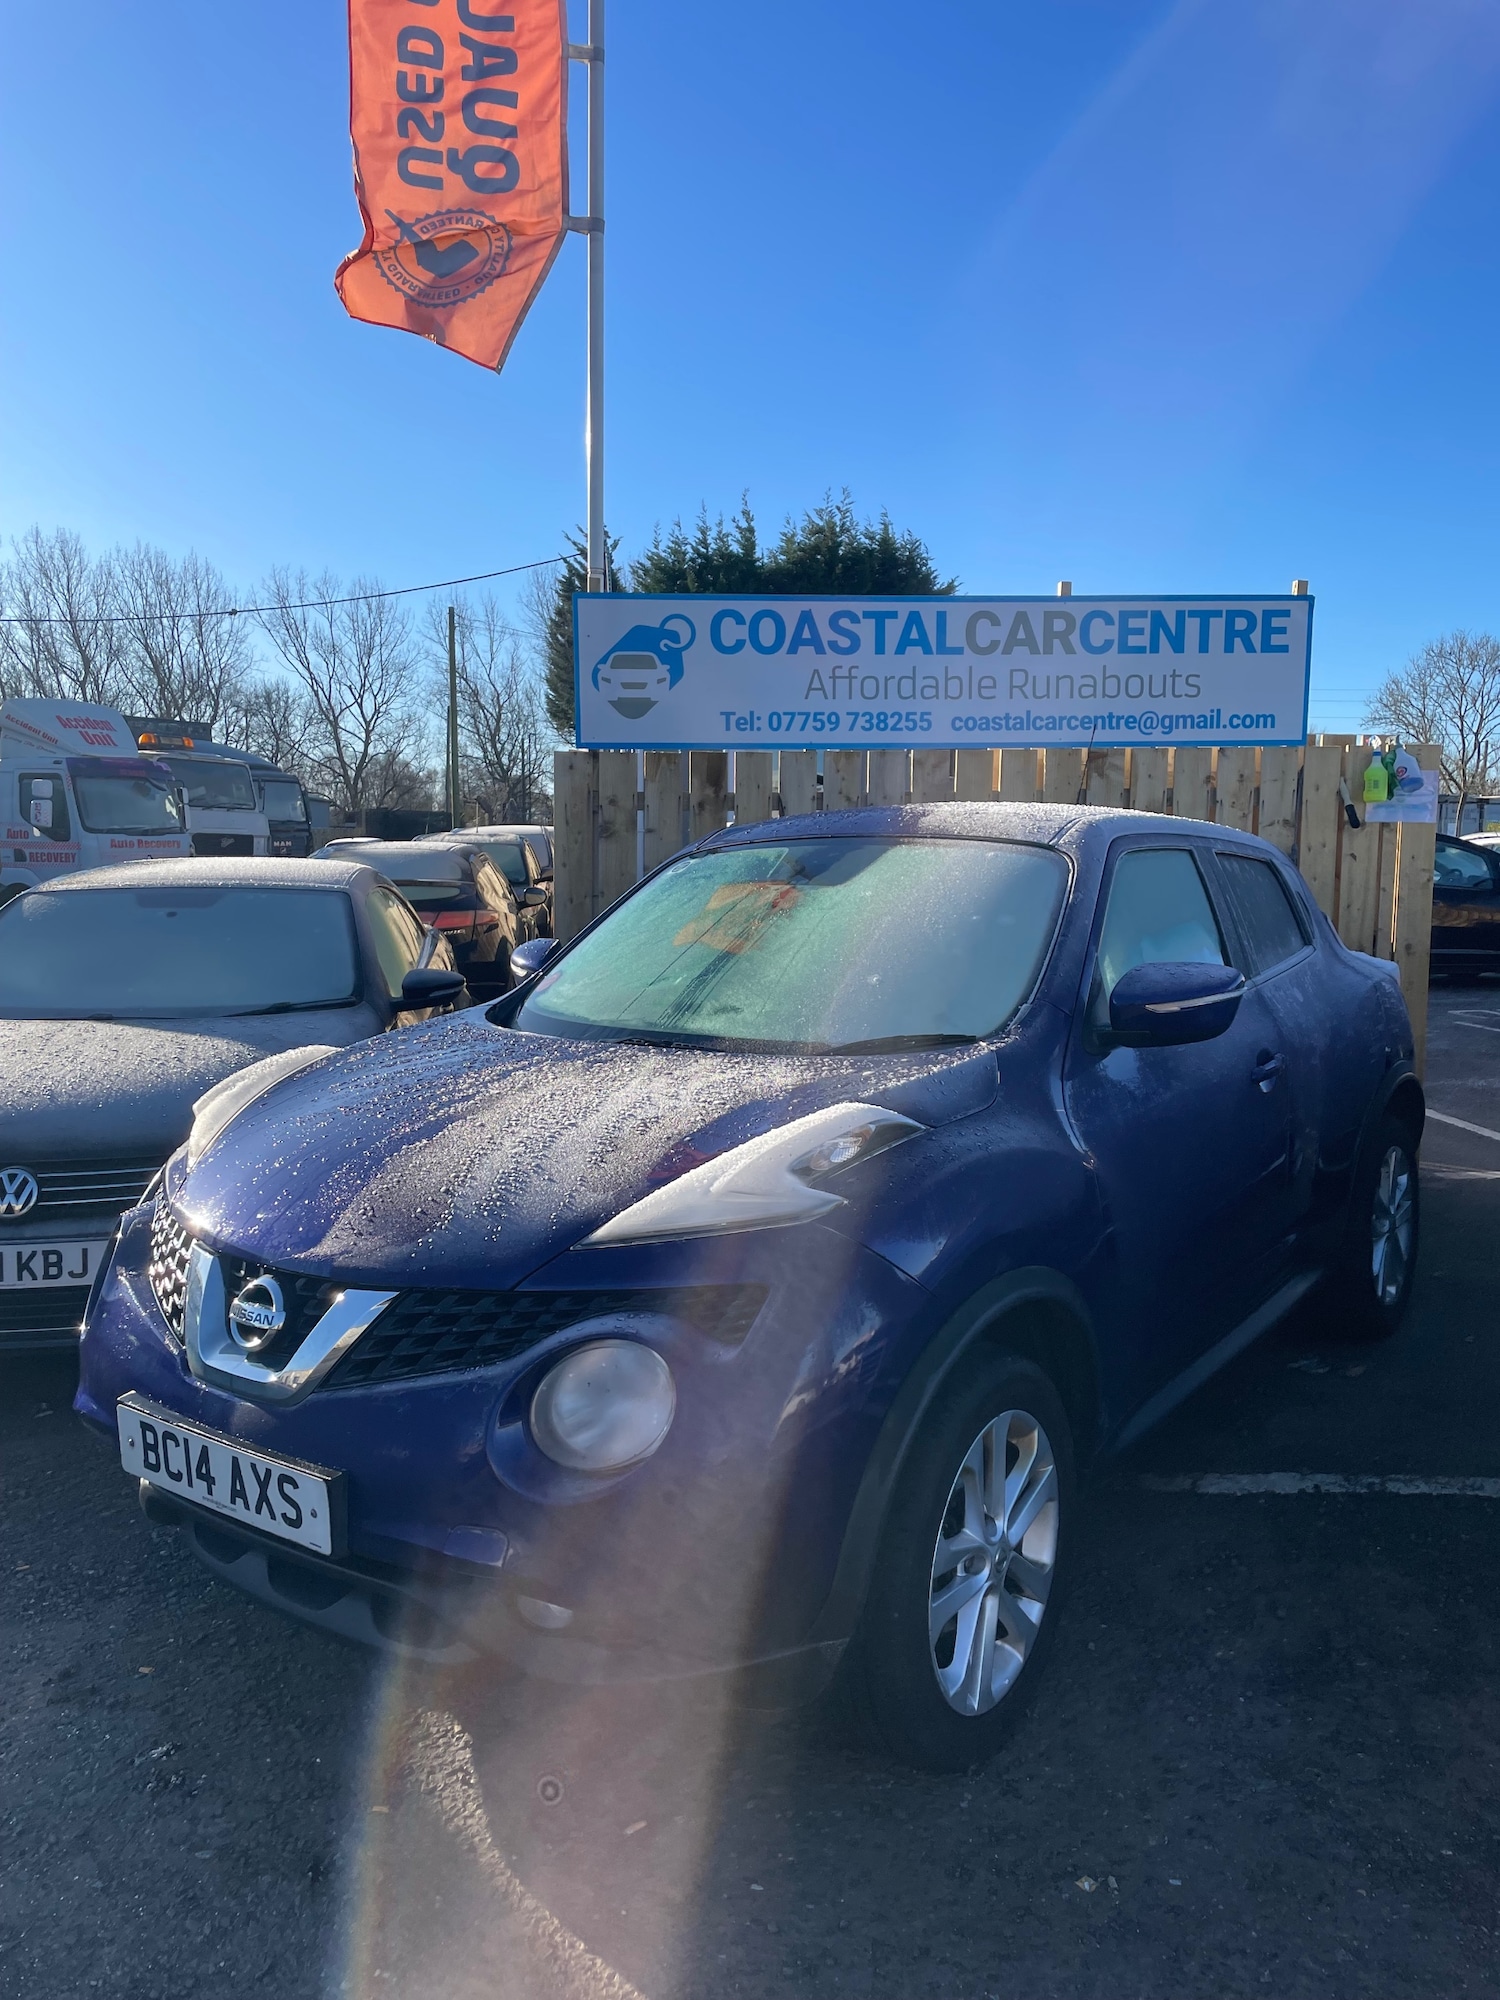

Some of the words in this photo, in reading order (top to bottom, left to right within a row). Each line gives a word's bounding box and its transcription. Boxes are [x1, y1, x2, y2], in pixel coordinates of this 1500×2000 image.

[709, 608, 1291, 656] COASTALCARCENTRE
[804, 665, 997, 701] Affordable
[1009, 664, 1201, 700] Runabouts
[5, 713, 42, 736] Accident
[42, 730, 59, 745] Unit
[56, 714, 118, 732] Accident
[720, 711, 761, 732] Tel:
[768, 711, 840, 732] 07759
[848, 711, 933, 732] 738255
[951, 708, 1276, 735] coastalcarcentre@gmail.com
[78, 730, 119, 747] Unit
[7, 828, 30, 840] Auto
[110, 838, 135, 849] Auto
[137, 838, 182, 850] Recovery
[273, 840, 292, 848] MAN
[29, 851, 77, 864] RECOVERY
[16, 1247, 89, 1282] KBJ
[139, 1419, 217, 1497] BC14
[229, 1455, 304, 1530] AXS
